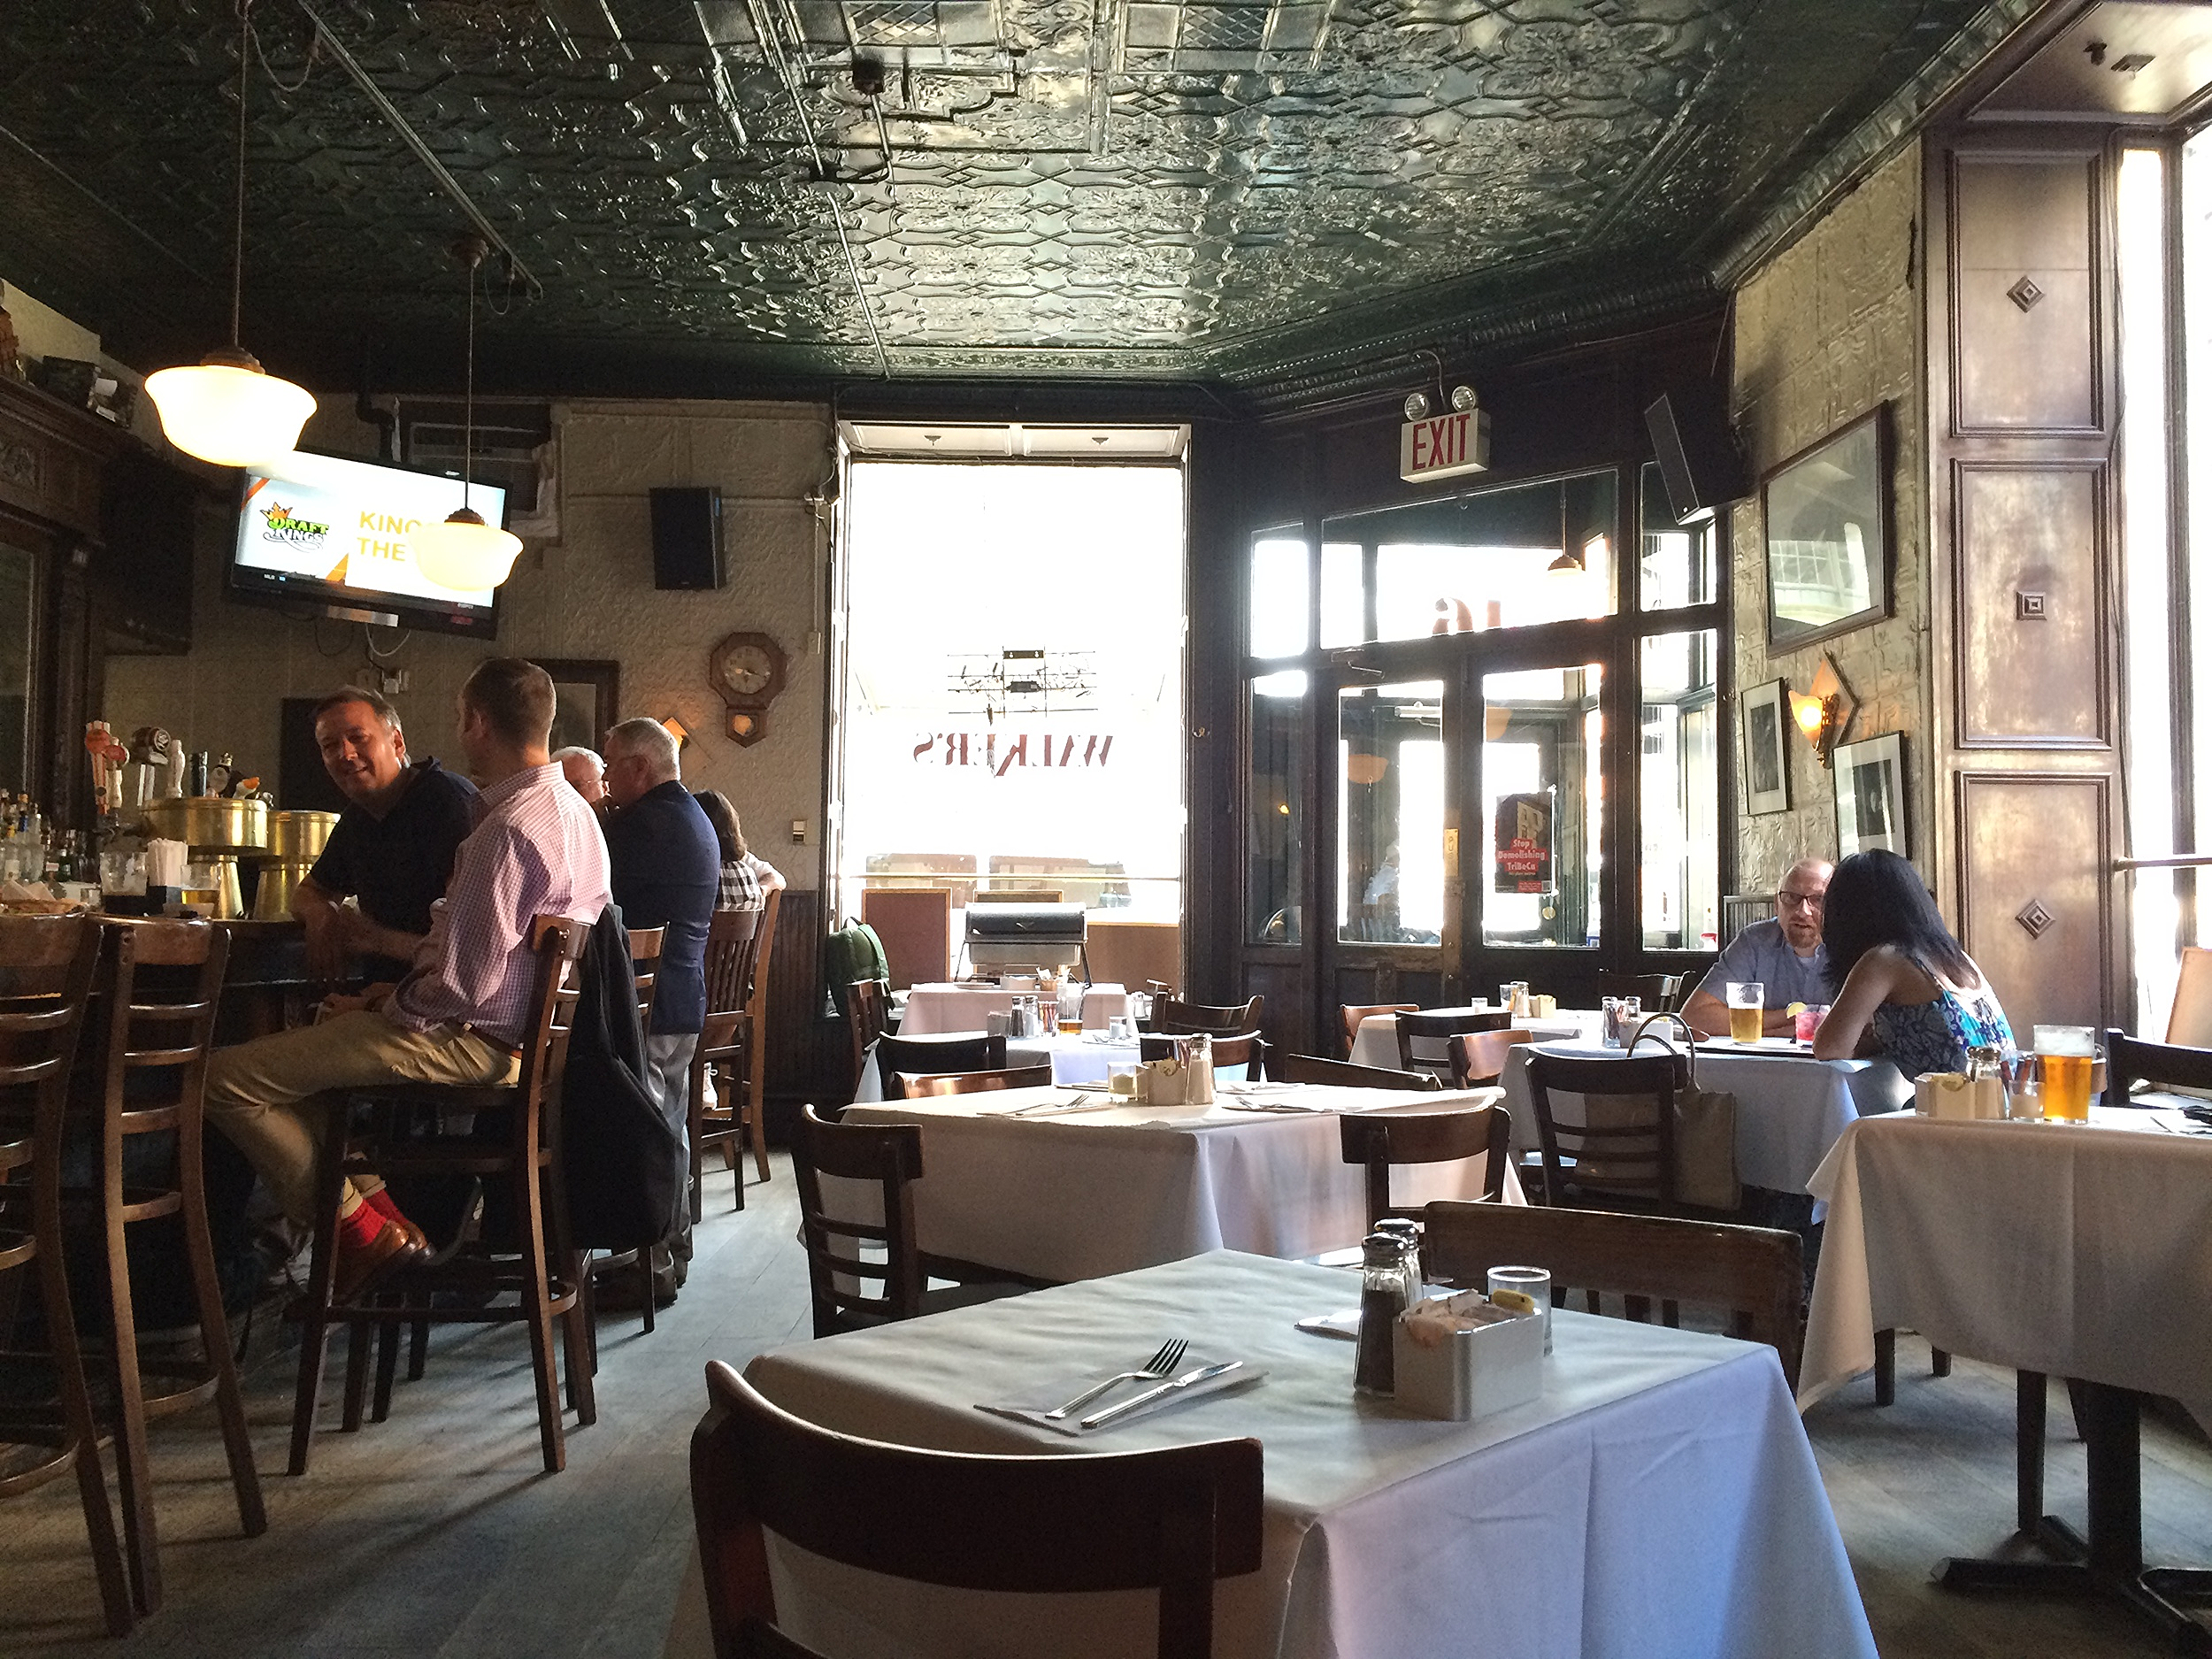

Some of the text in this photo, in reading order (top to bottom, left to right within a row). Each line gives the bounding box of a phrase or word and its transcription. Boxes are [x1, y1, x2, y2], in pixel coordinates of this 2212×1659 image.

[1412, 412, 1471, 471] EXIT
[267, 518, 329, 534] DRAFT
[263, 528, 324, 550] KINGS
[357, 537, 406, 562] THE
[1513, 839, 1530, 849] Stop
[1498, 849, 1546, 861] Demolishing
[1507, 862, 1536, 871] TriBeCa
